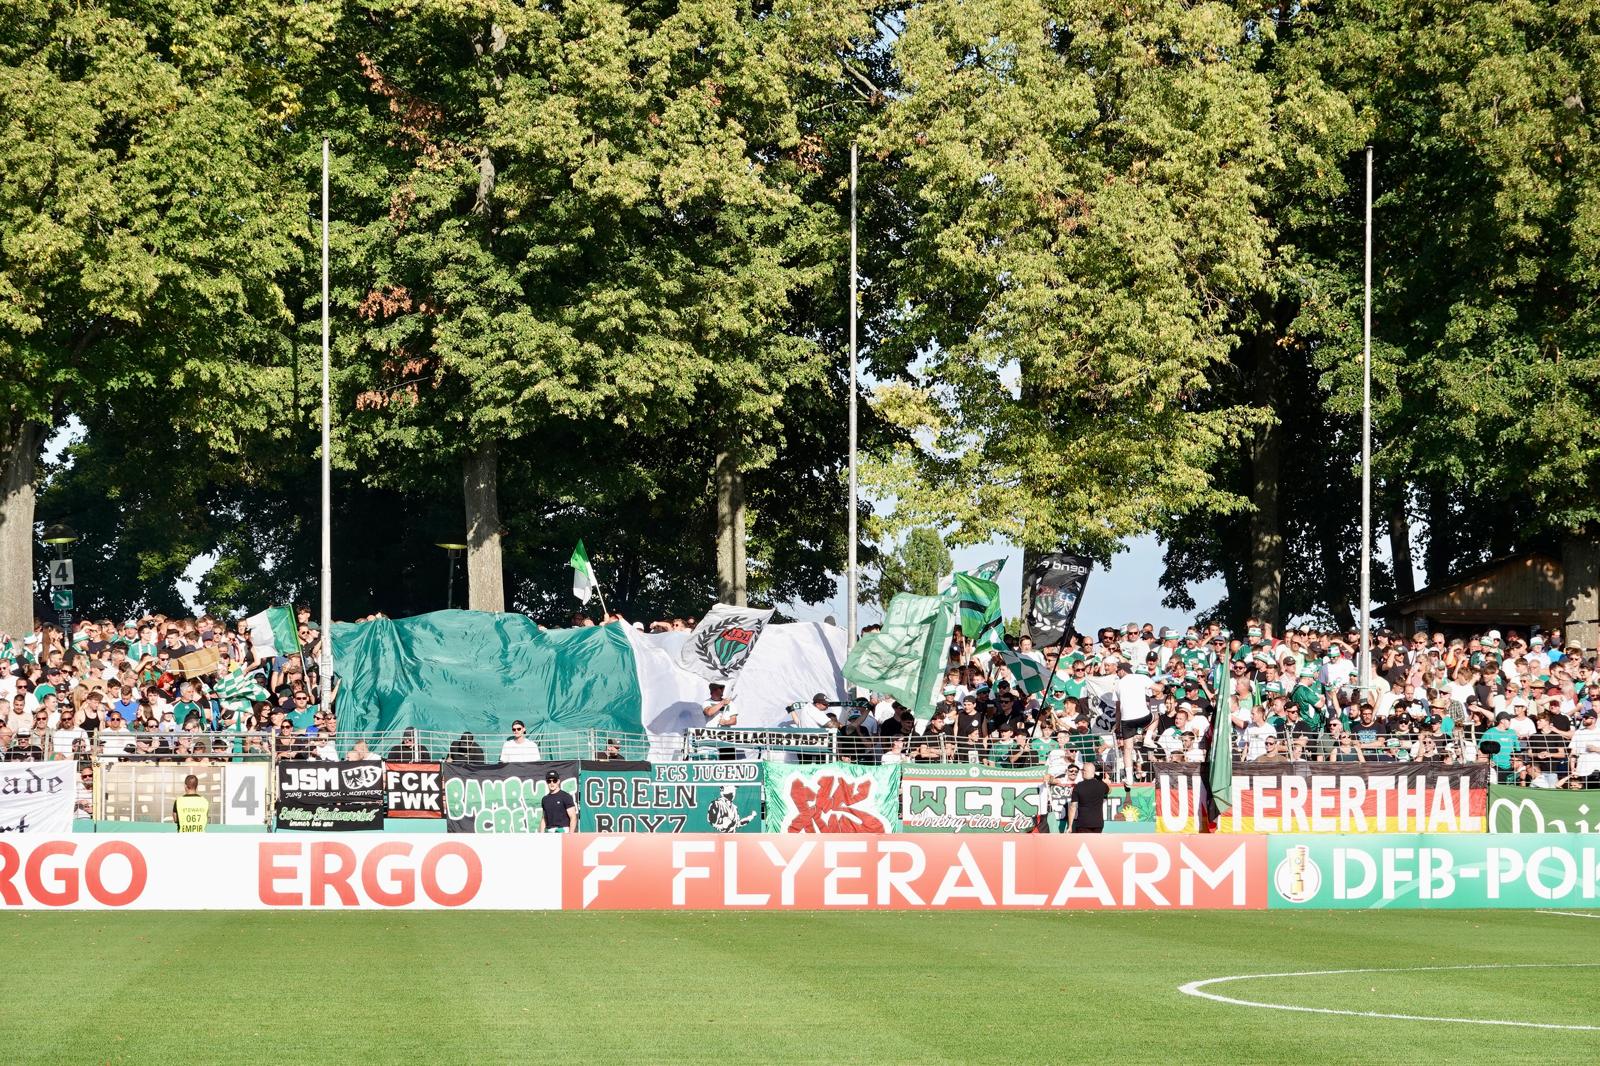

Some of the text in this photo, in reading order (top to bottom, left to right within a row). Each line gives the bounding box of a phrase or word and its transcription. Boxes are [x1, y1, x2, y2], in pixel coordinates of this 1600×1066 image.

[55, 562, 68, 582] 4
[694, 729, 828, 746] KUGELLAGERSTADT
[281, 767, 339, 791] JSM
[387, 771, 440, 791] FCK
[655, 764, 758, 781] FCS JUGEND
[231, 775, 259, 816] 4
[388, 792, 440, 811] FWK
[444, 776, 579, 820] BAMBU
[585, 777, 698, 809] GREEN
[910, 785, 1039, 817] WCK
[186, 814, 202, 823] 067
[595, 814, 688, 833] BOYZ
[911, 811, 1034, 833] Working Class Kid
[258, 841, 483, 907] ERGO
[672, 841, 1247, 906] FLYERALARM
